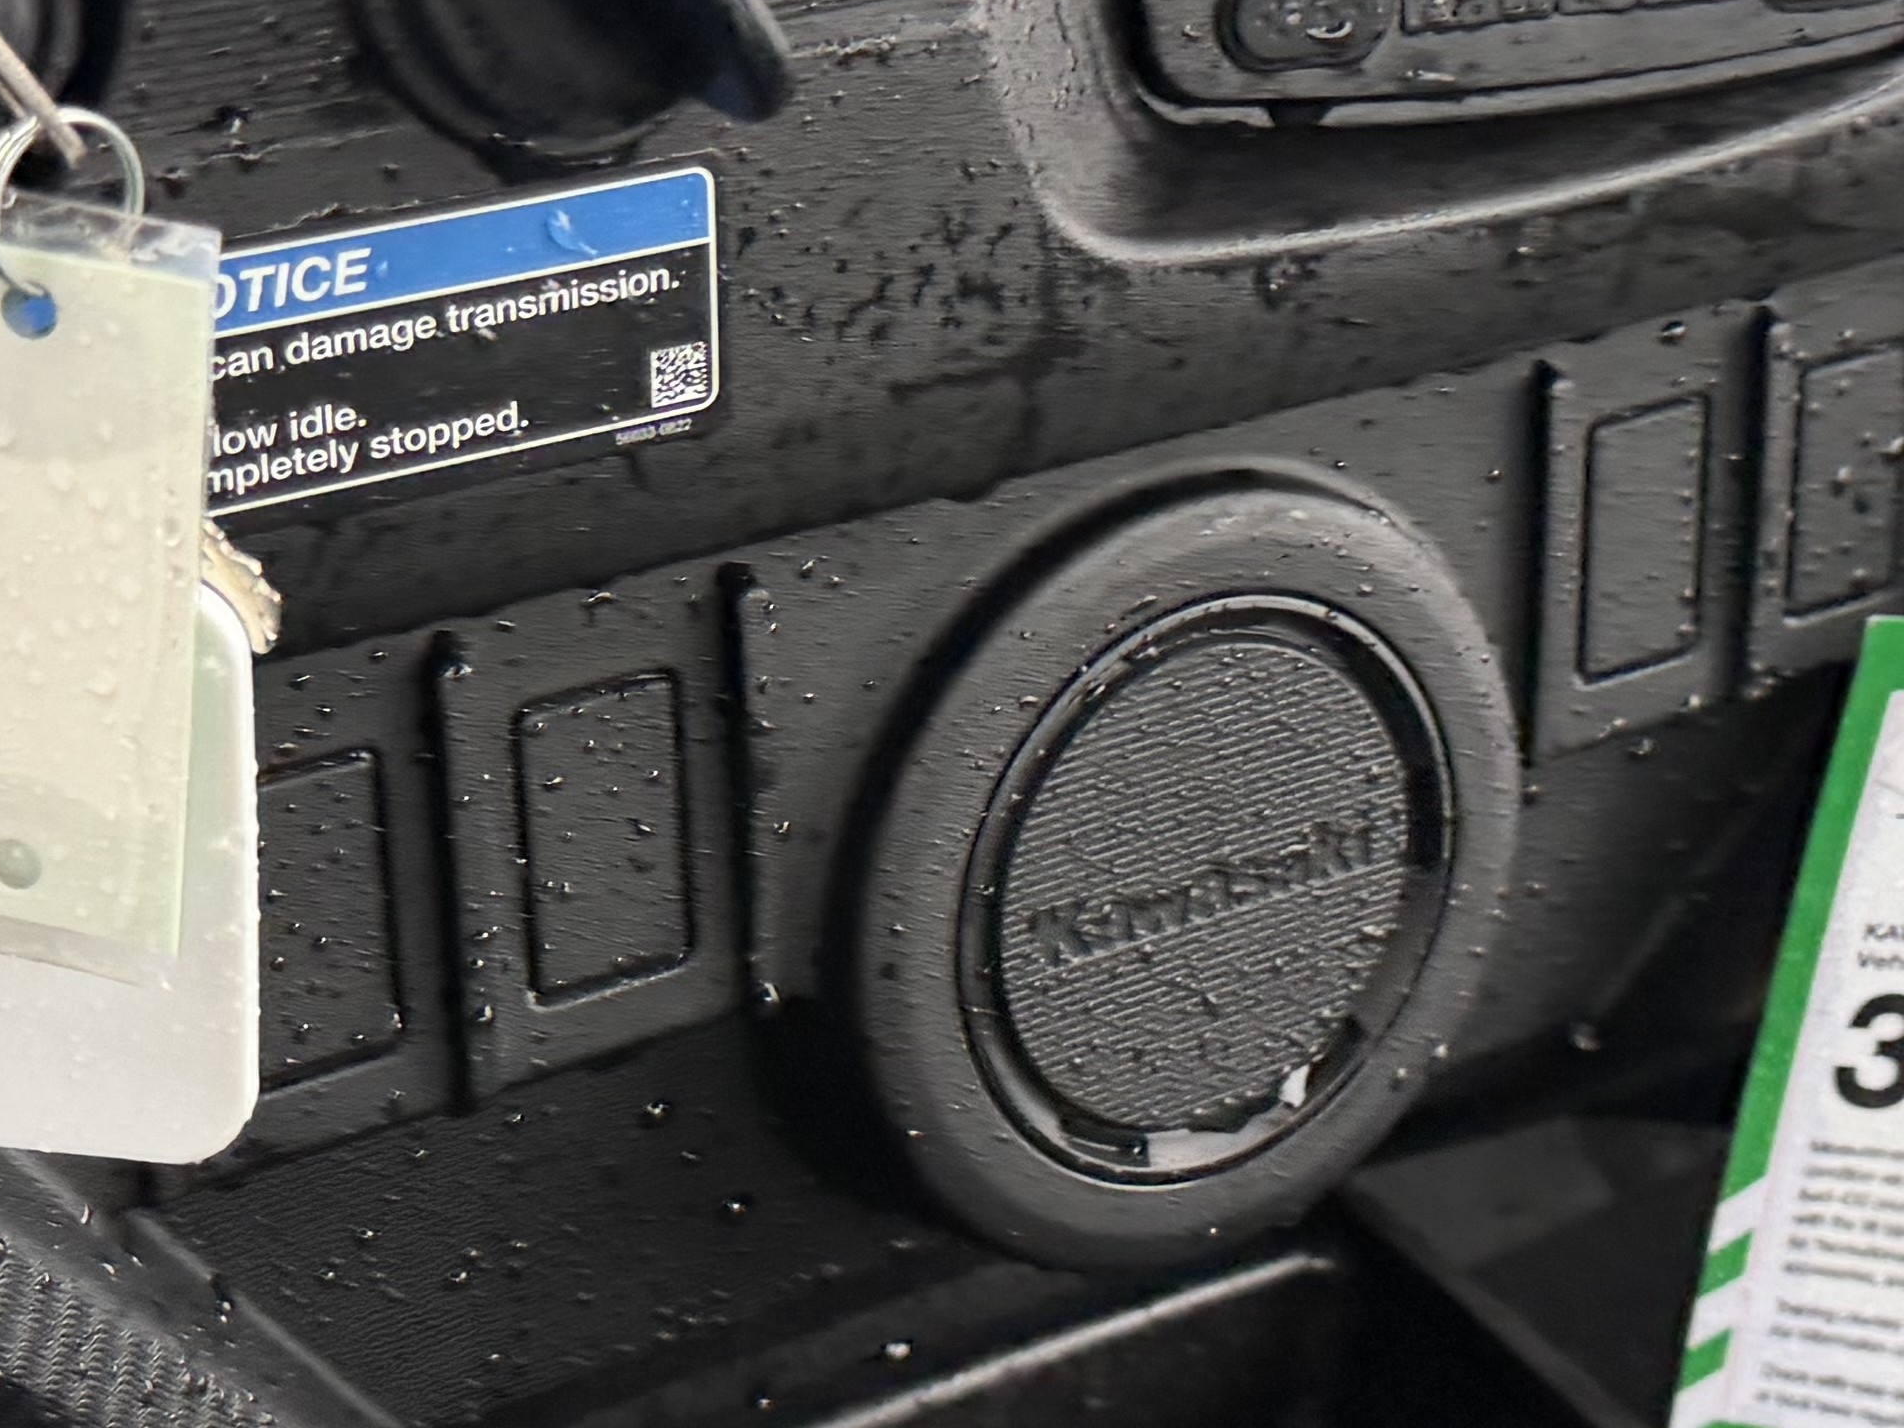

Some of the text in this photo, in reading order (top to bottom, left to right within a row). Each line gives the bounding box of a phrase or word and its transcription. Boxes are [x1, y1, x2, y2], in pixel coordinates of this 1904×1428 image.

[212, 246, 373, 320] OTICE
[285, 315, 438, 367] damage
[446, 265, 682, 335] transmission.
[208, 436, 358, 497] mpletely
[370, 400, 530, 460] stopped.
[289, 403, 367, 443] idle.
